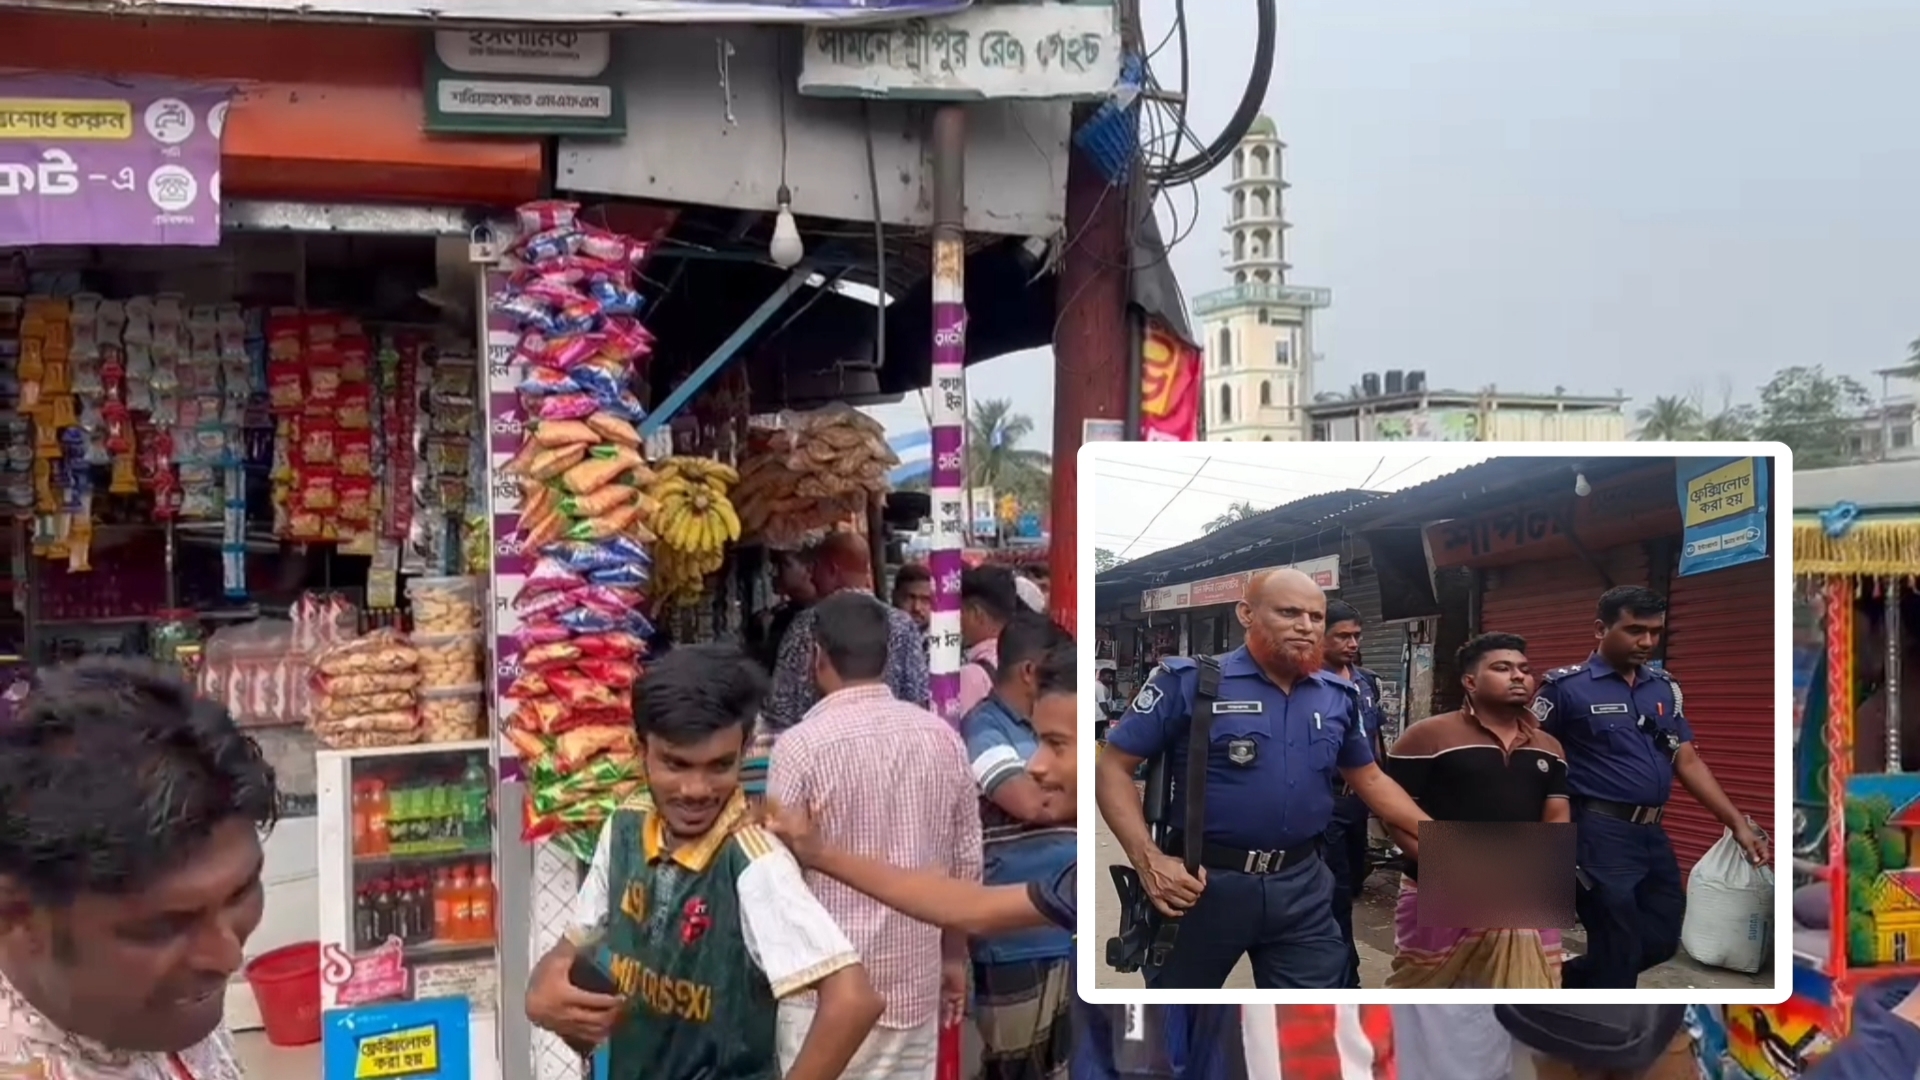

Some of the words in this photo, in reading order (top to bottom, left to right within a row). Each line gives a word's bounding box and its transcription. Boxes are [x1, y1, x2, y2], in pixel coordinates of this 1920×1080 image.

[901, 17, 969, 75] শ্রীপুর
[62, 111, 125, 131] করুন
[1699, 498, 1722, 513] করা
[1725, 492, 1744, 507] হয়
[1748, 913, 1759, 941] SUGAR
